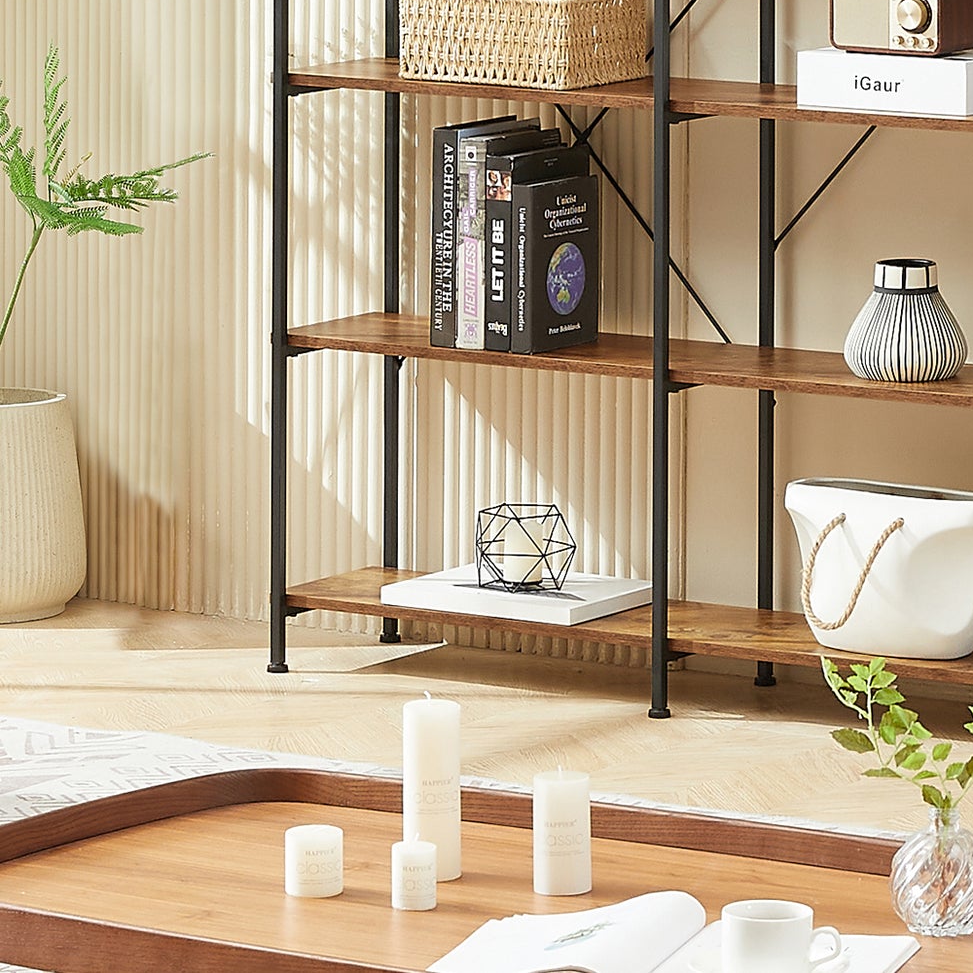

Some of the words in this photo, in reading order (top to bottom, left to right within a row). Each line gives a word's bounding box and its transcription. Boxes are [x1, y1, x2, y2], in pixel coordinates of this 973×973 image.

[854, 75, 901, 93] iGaur
[544, 203, 587, 219] Organizational
[491, 219, 504, 244] BE
[549, 217, 583, 231] Cybernetics
[491, 246, 504, 266] IT
[442, 261, 453, 278] IN
[465, 242, 476, 315] HEARTLESS
[491, 268, 504, 301] LET
[442, 280, 453, 312] THE
[434, 287, 443, 331] CENTURY
